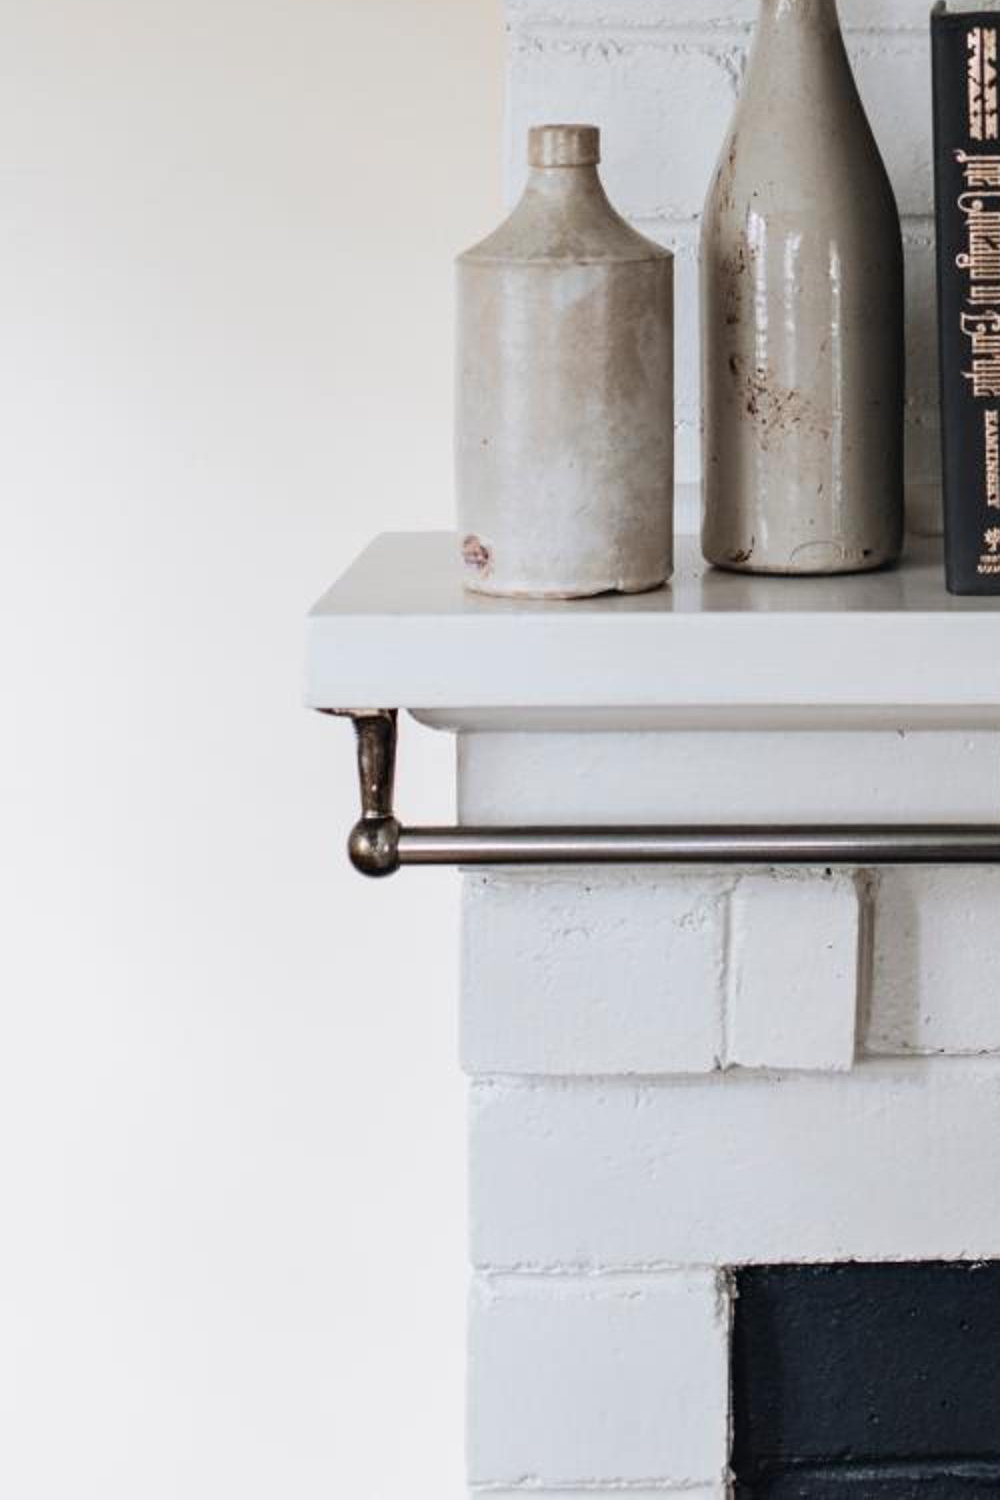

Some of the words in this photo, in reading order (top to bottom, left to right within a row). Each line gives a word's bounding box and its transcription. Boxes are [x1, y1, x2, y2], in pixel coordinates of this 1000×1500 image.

[967, 27, 983, 140] TWAIN
[983, 27, 997, 139] MARK
[984, 409, 1000, 508] KAMINSKY
